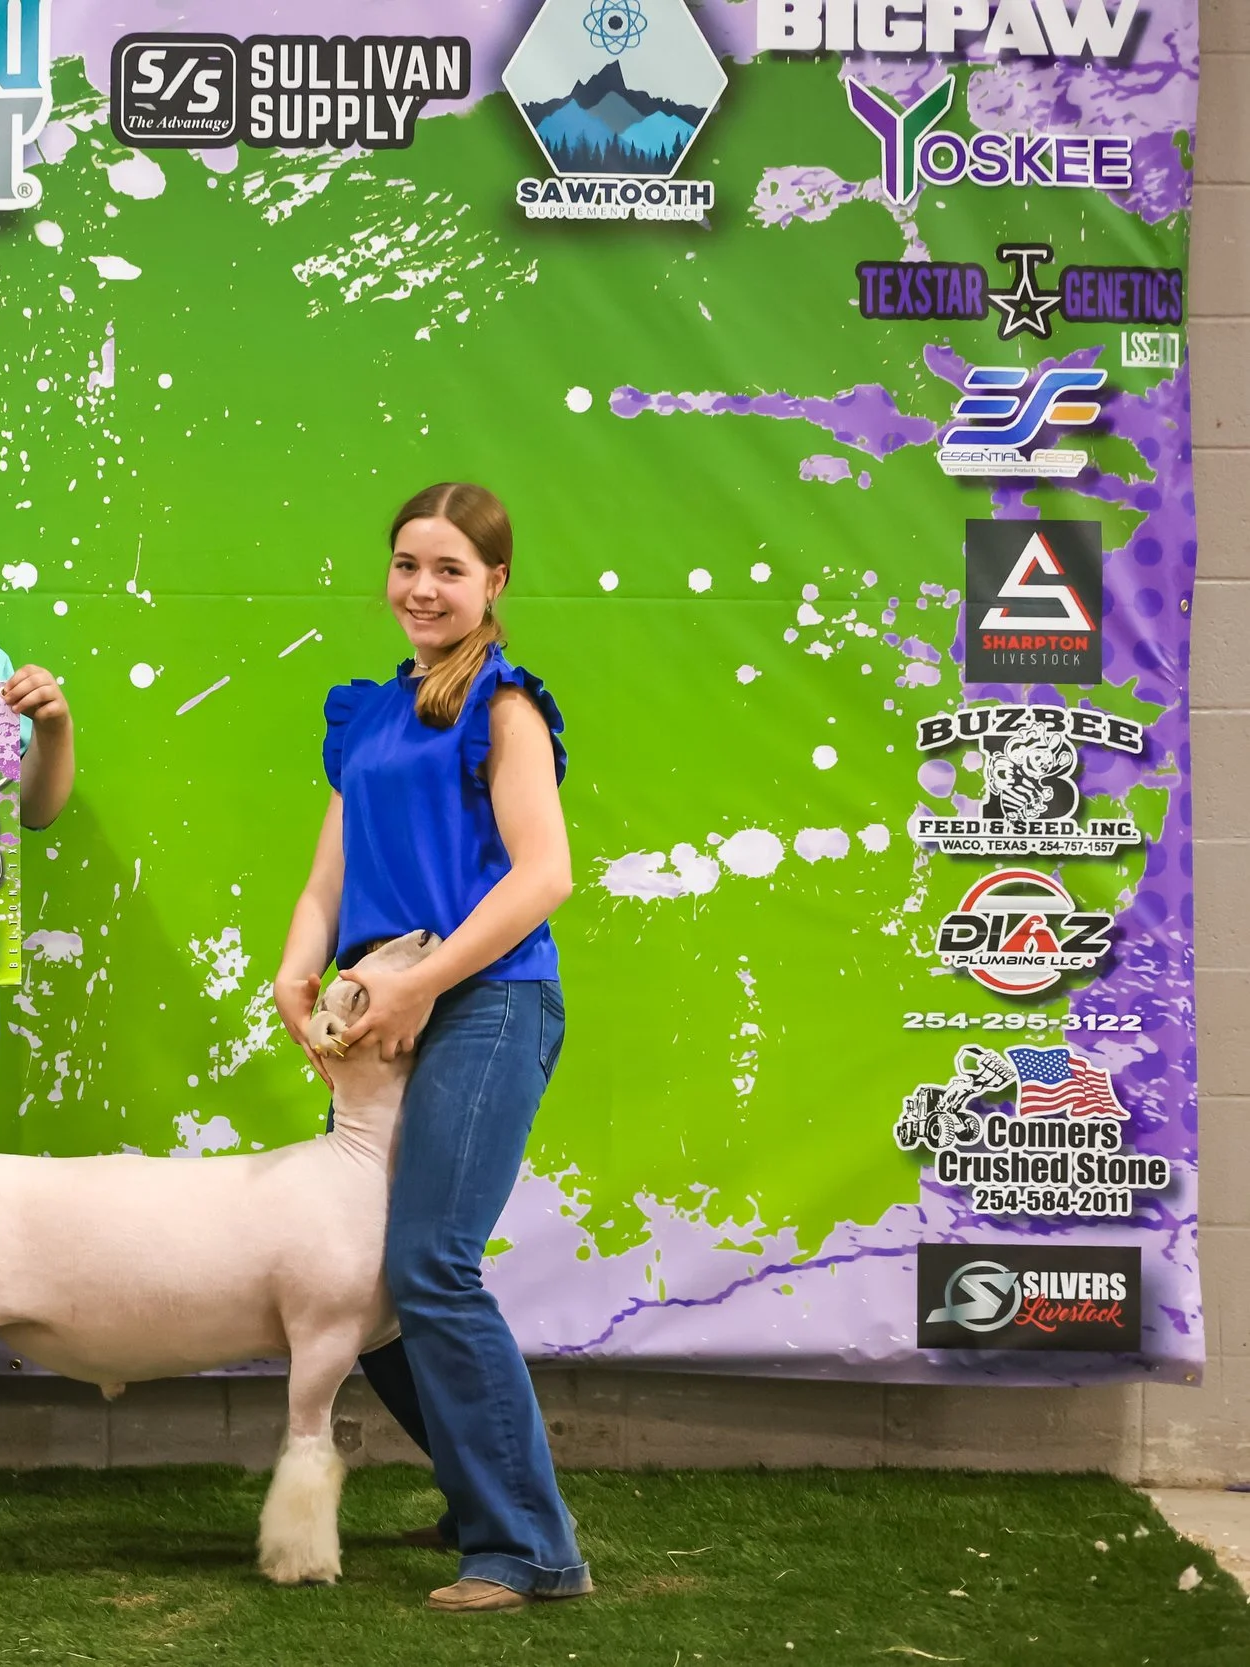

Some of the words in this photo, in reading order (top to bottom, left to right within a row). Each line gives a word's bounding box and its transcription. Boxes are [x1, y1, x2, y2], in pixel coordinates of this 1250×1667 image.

[757, 0, 1140, 57] BIGPAW
[250, 44, 462, 91] SULLIVAN
[128, 114, 153, 130] The
[157, 114, 230, 133] Advantage
[250, 95, 415, 140] SUPPLY
[848, 78, 1128, 201] YOSKEE
[519, 181, 711, 206] SAWTOOTH
[528, 206, 627, 217] SUPPLEMENT
[633, 207, 702, 218] SCIENCE
[862, 267, 983, 315] TEXSTAR
[1065, 270, 1182, 320] GENETICS
[940, 451, 1023, 462] ESSENTIAL
[1035, 453, 1084, 464] FEEDS
[982, 635, 1088, 651] SHARPTON
[993, 653, 1081, 666] LIVESTOCK
[920, 708, 1139, 750] BUZBEE
[919, 821, 980, 835] FEED
[989, 821, 1004, 835] &
[1092, 822, 1137, 836] INC.
[943, 841, 984, 853] WACO,
[988, 841, 1028, 851] TEXAS
[1040, 841, 1114, 852] 254-757-1557
[939, 914, 1111, 953] DIAZ
[956, 955, 1045, 966] PLUMBING
[1050, 956, 1081, 966] LLC
[903, 1012, 1142, 1032] 254-295-3122
[988, 1115, 1117, 1148] Conners
[939, 1152, 1069, 1184] Crushed
[1077, 1153, 1166, 1186] Stone
[976, 1190, 1129, 1213] 254-584-2011
[1023, 1271, 1127, 1301] SILVERS
[1015, 1294, 1125, 1333] Livestock
